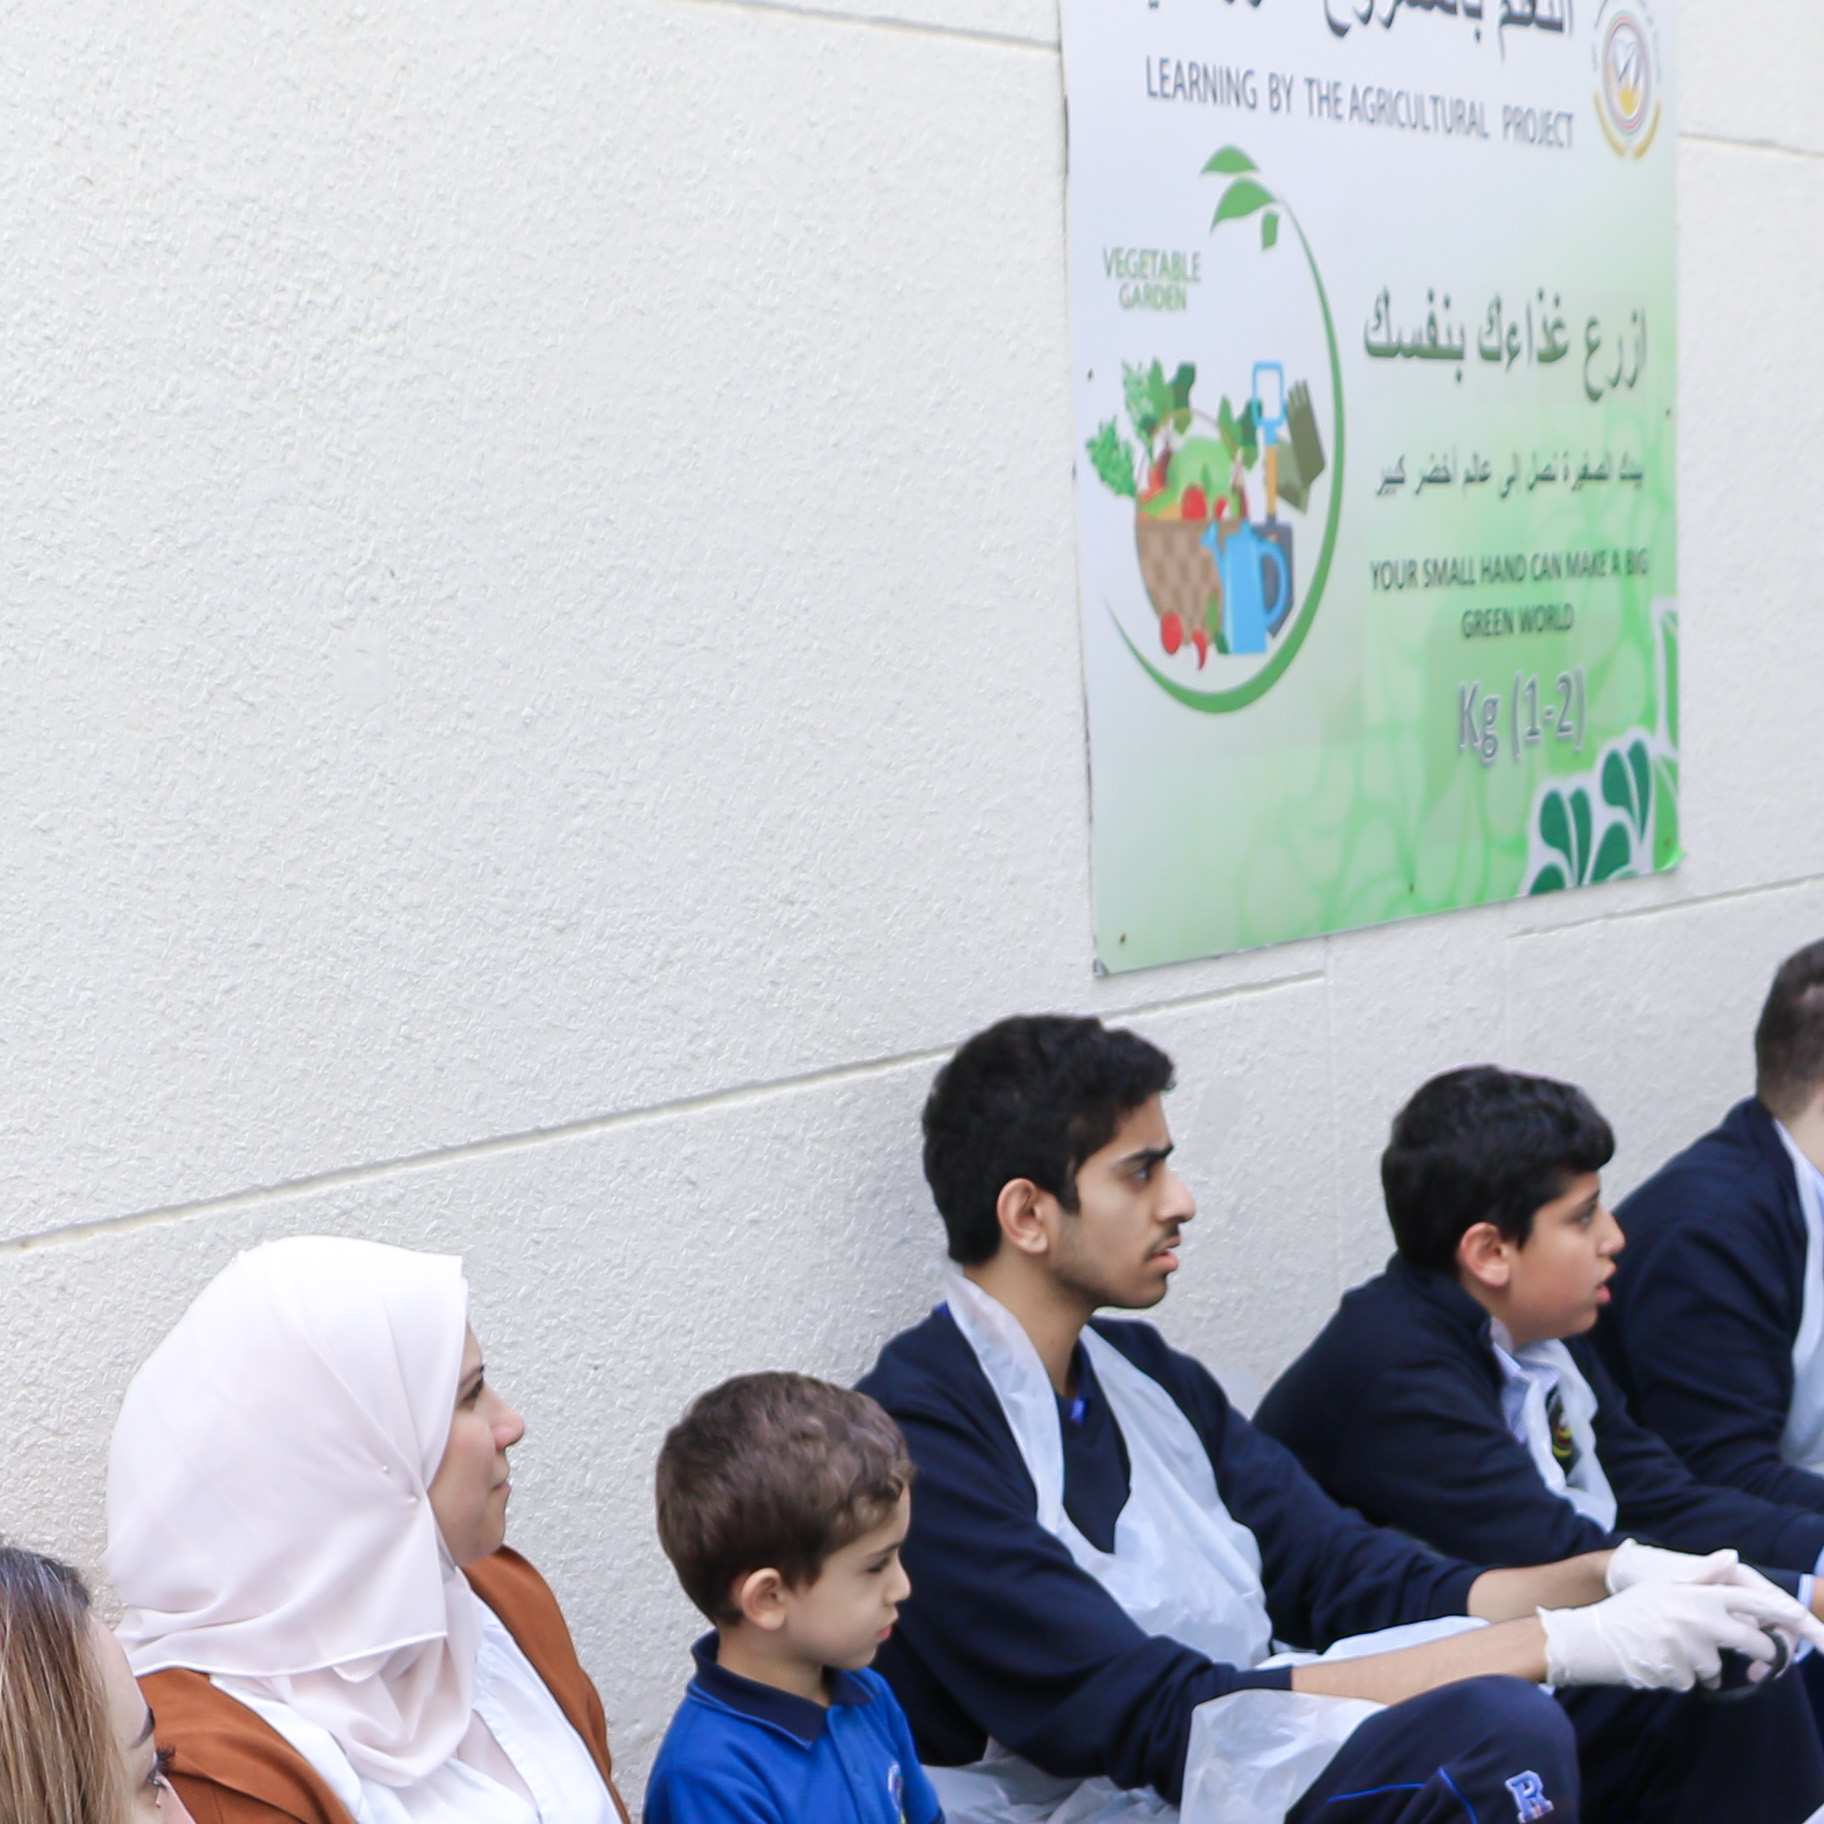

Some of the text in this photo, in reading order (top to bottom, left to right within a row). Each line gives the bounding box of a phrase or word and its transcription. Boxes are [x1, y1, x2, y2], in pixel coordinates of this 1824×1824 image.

[1145, 54, 1574, 148] LEARNING BY THE AGRICULTURAL PROJECT
[1102, 245, 1201, 283] VEGETABLE
[1119, 282, 1187, 311] GARDEN
[1364, 284, 1465, 384] بنفسك
[1478, 285, 1569, 373] غذاءك
[1370, 546, 1650, 590] YOUR SMALL HAND CAN MAKE A BIG
[1461, 601, 1574, 640] GREEN WORLD
[1458, 667, 1585, 764] Kg (1-2)
